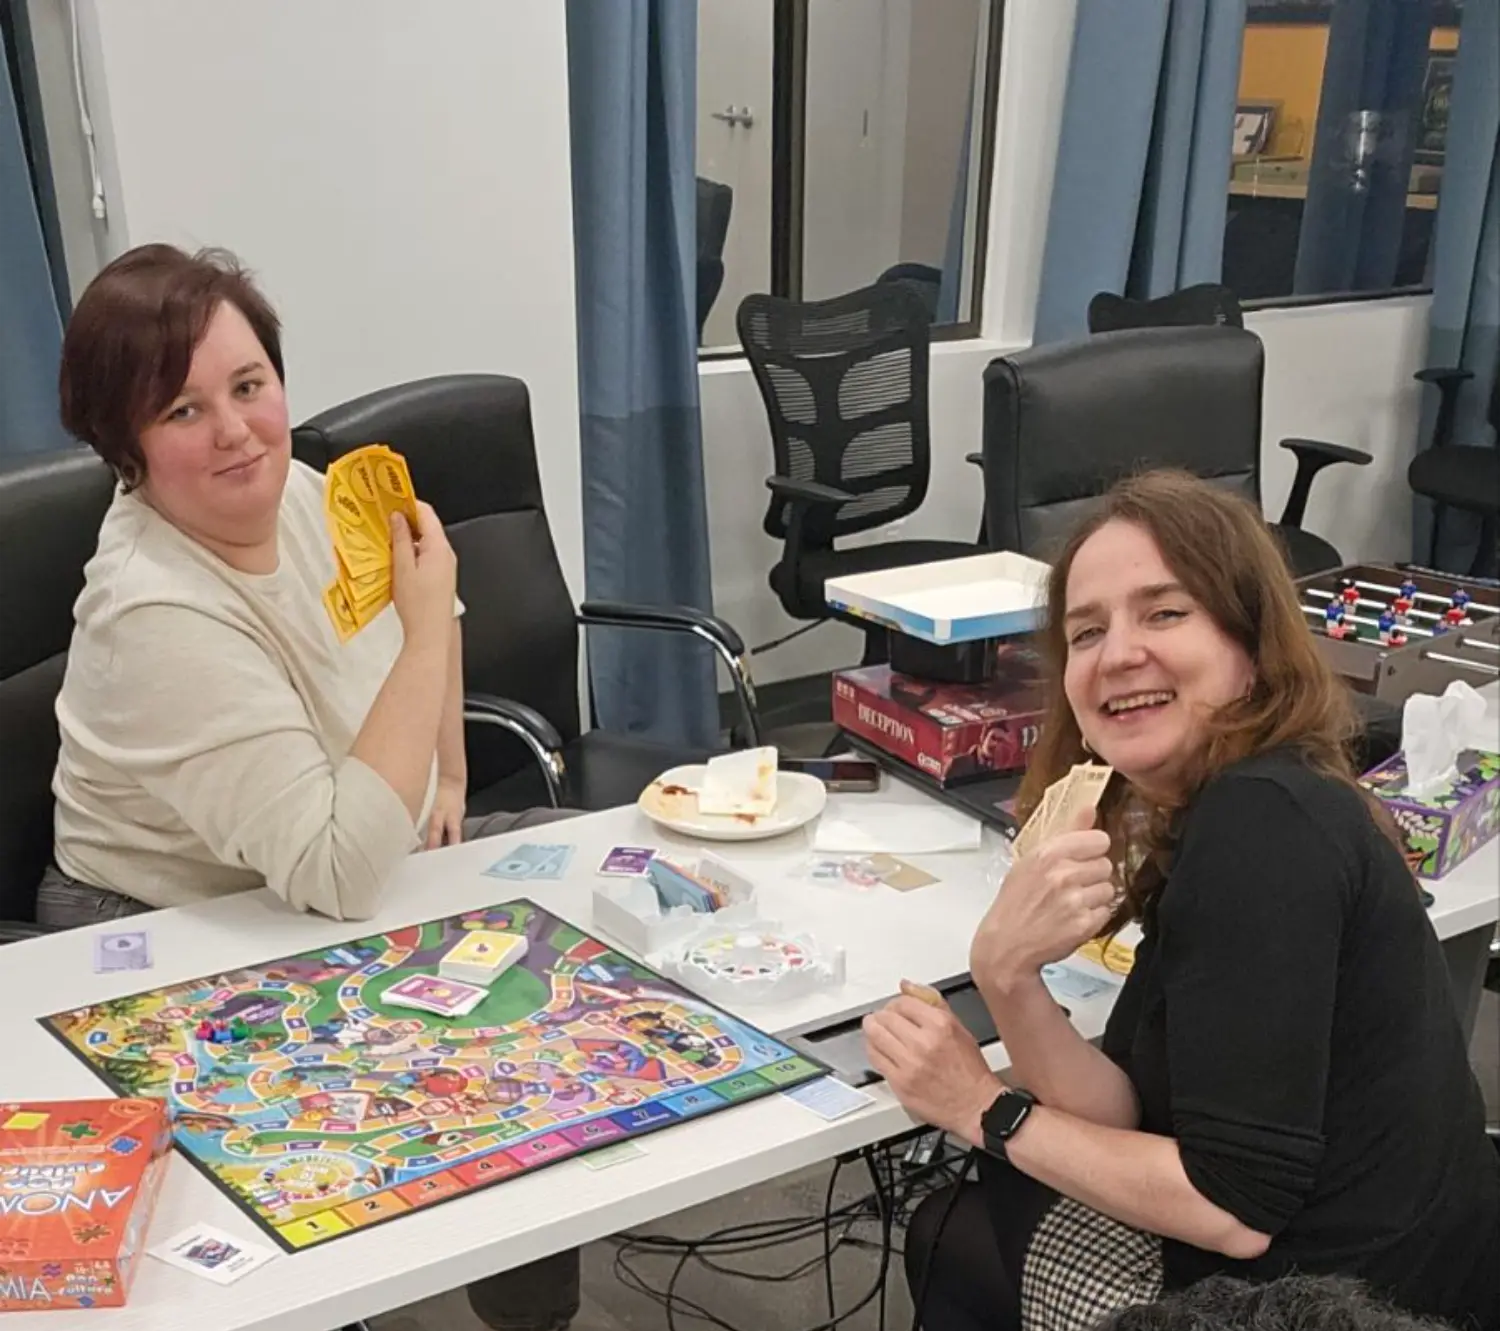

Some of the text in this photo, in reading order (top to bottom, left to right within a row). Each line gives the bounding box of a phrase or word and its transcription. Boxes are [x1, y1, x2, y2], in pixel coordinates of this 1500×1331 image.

[858, 702, 914, 745] DECEPTION
[775, 1063, 797, 1073] 10
[364, 1201, 380, 1211] 2
